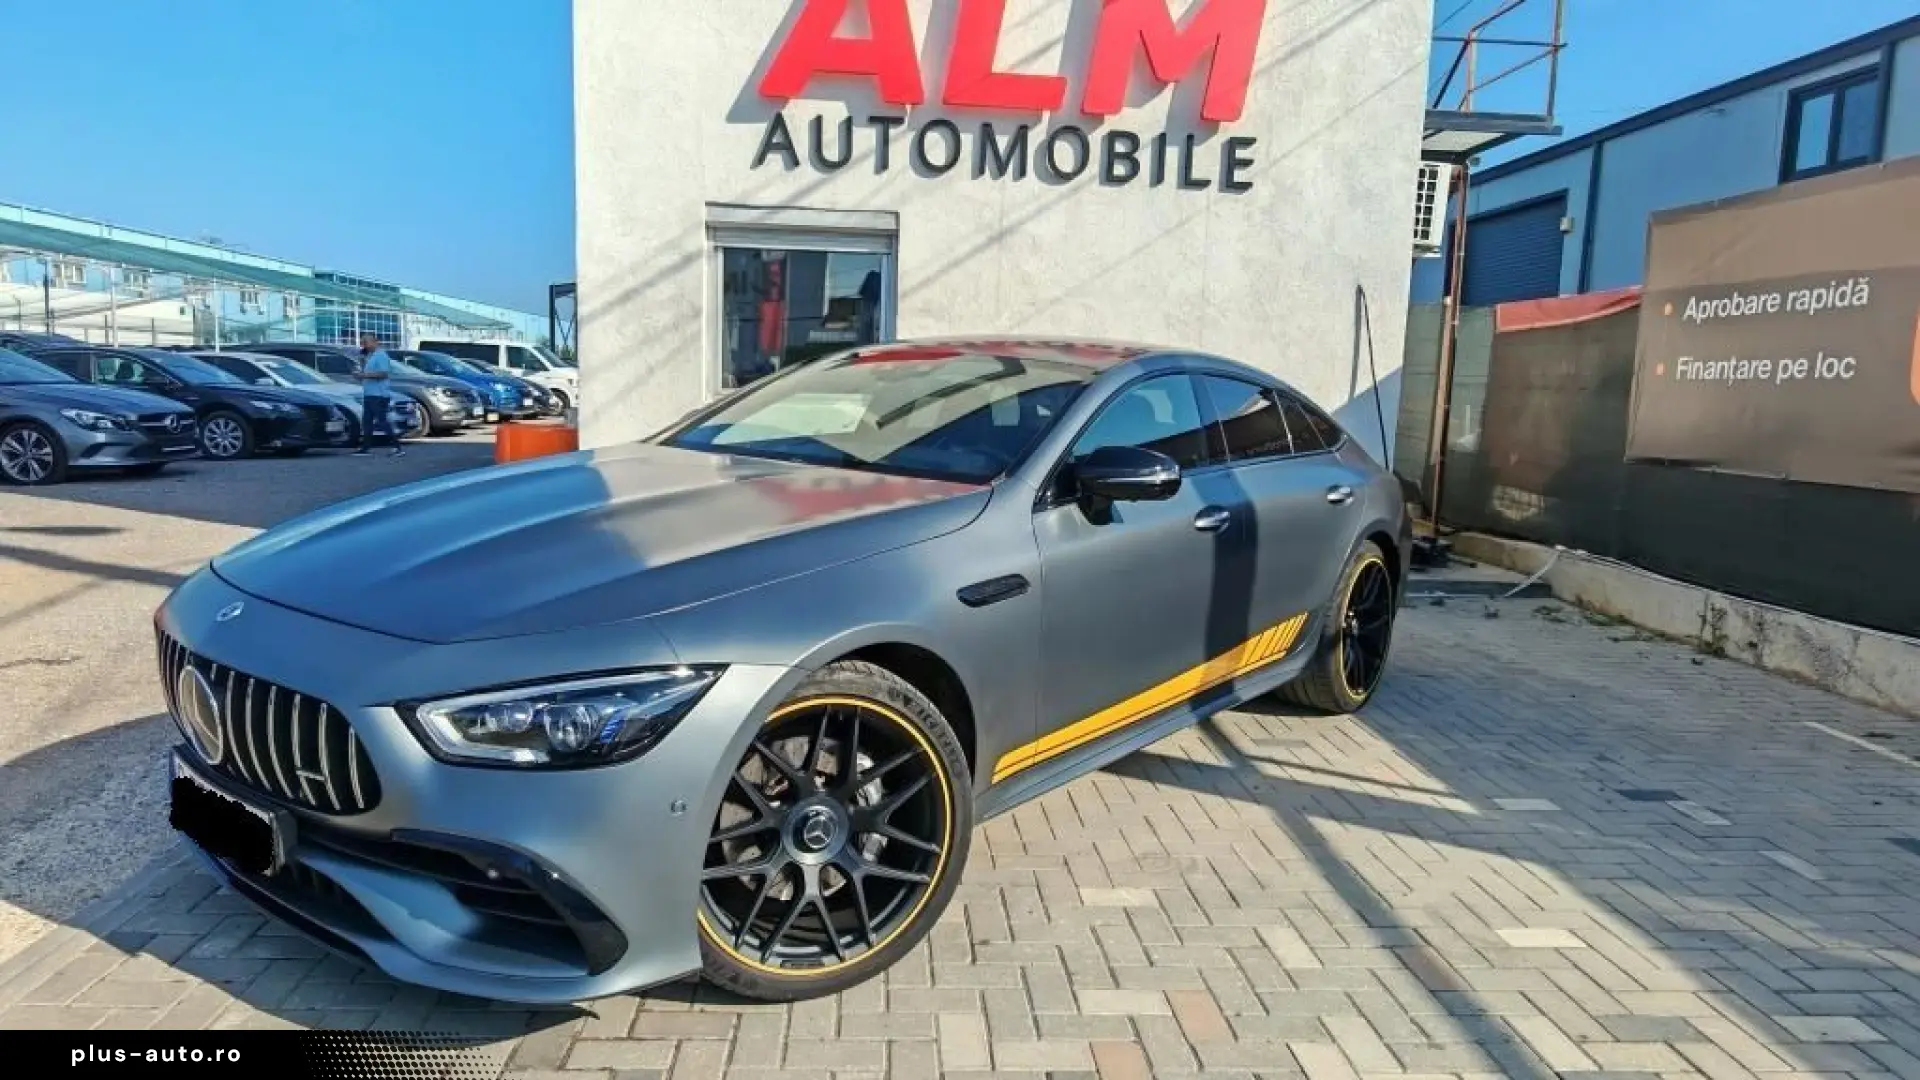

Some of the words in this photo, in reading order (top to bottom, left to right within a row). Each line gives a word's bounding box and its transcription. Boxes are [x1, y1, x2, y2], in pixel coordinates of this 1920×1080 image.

[759, 0, 1267, 123] ALM
[753, 113, 1257, 191] AUTOMOBILE
[1682, 291, 1782, 324] Aprobare
[1786, 277, 1871, 315] rapidă
[1776, 358, 1809, 384] pe
[1814, 352, 1857, 379] loc
